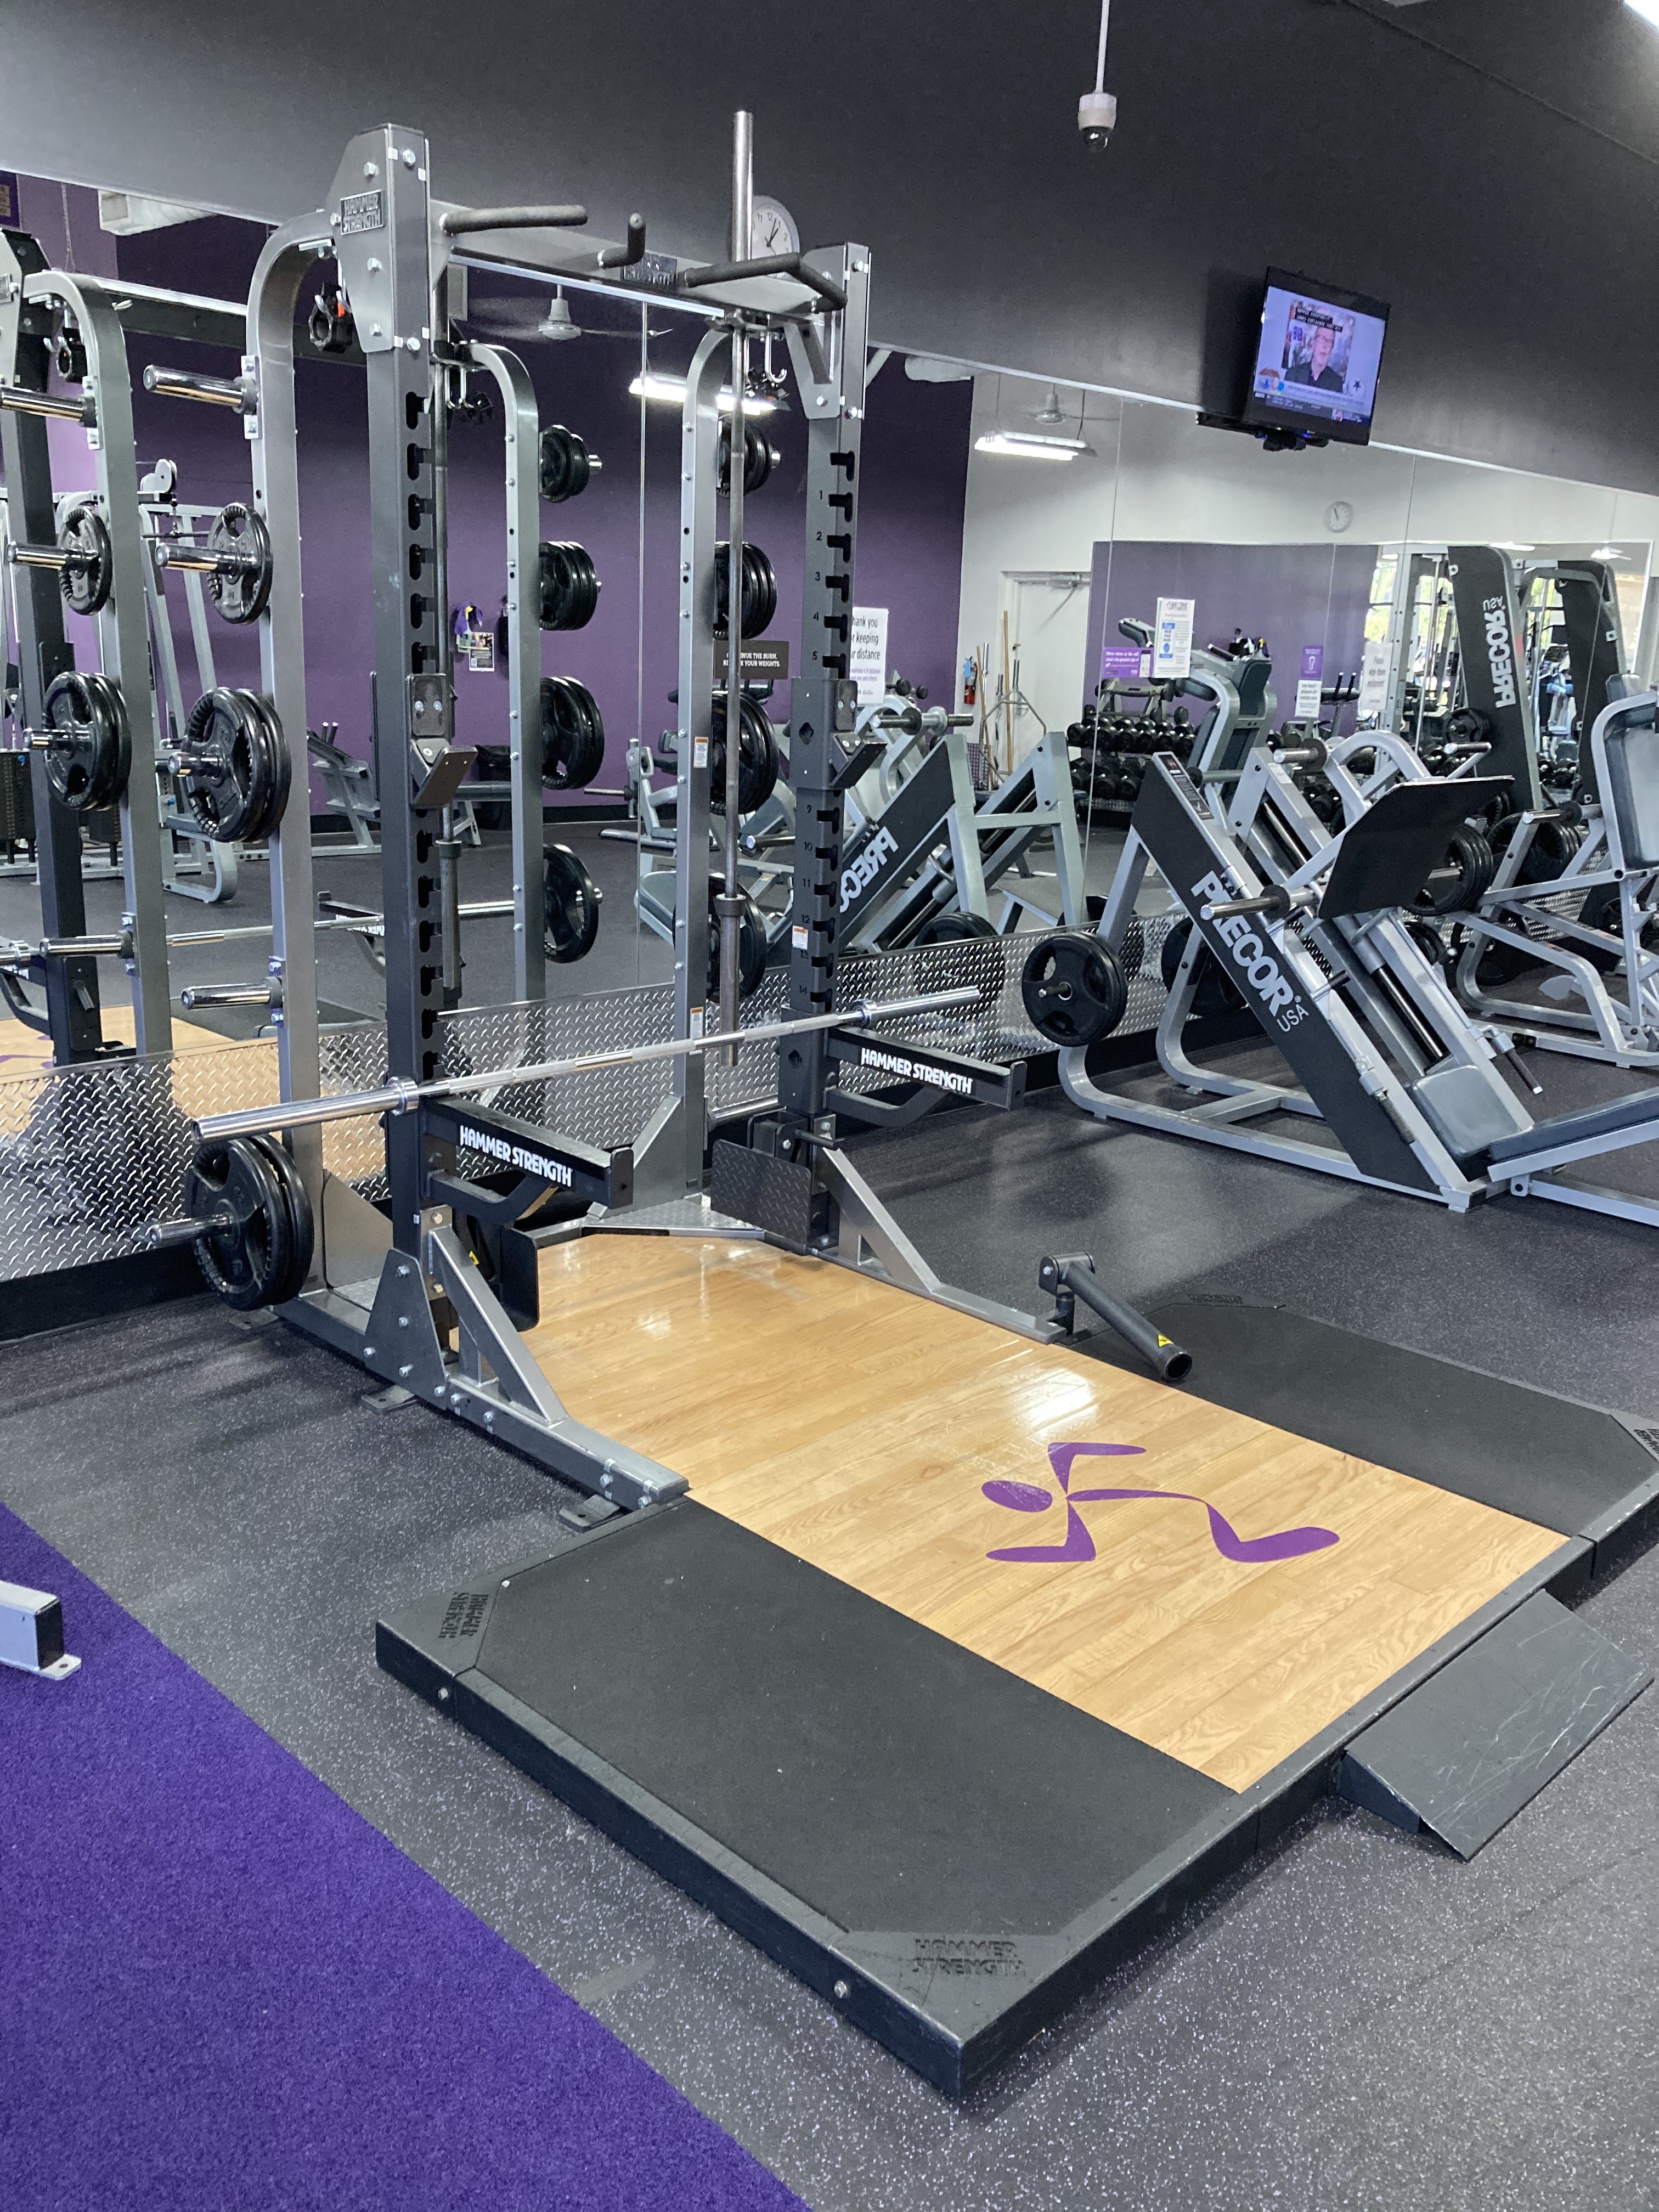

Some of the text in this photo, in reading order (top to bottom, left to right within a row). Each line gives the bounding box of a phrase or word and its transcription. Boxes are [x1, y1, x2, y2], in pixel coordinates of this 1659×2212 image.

[344, 193, 378, 216] HAMMER
[343, 209, 380, 232] STRENGTH
[767, 212, 773, 222] 12
[783, 232, 788, 242] 2
[819, 490, 823, 500] 1
[816, 531, 822, 541] 2
[815, 571, 821, 582] 3
[812, 611, 819, 621] 4
[852, 616, 878, 629] hank you
[856, 632, 879, 646] keeping
[812, 651, 817, 661] 5
[857, 648, 881, 660] distance
[804, 842, 812, 851] 10
[803, 878, 810, 888] 11
[801, 914, 810, 924] 12
[1277, 1004, 1309, 1032] USA
[861, 1047, 972, 1094] HAMMER STRENGTH
[460, 1125, 572, 1187] HAMMER STRENGTH
[915, 1939, 1018, 1958] HAMMER
[912, 1957, 1026, 1976] STRENGTH
